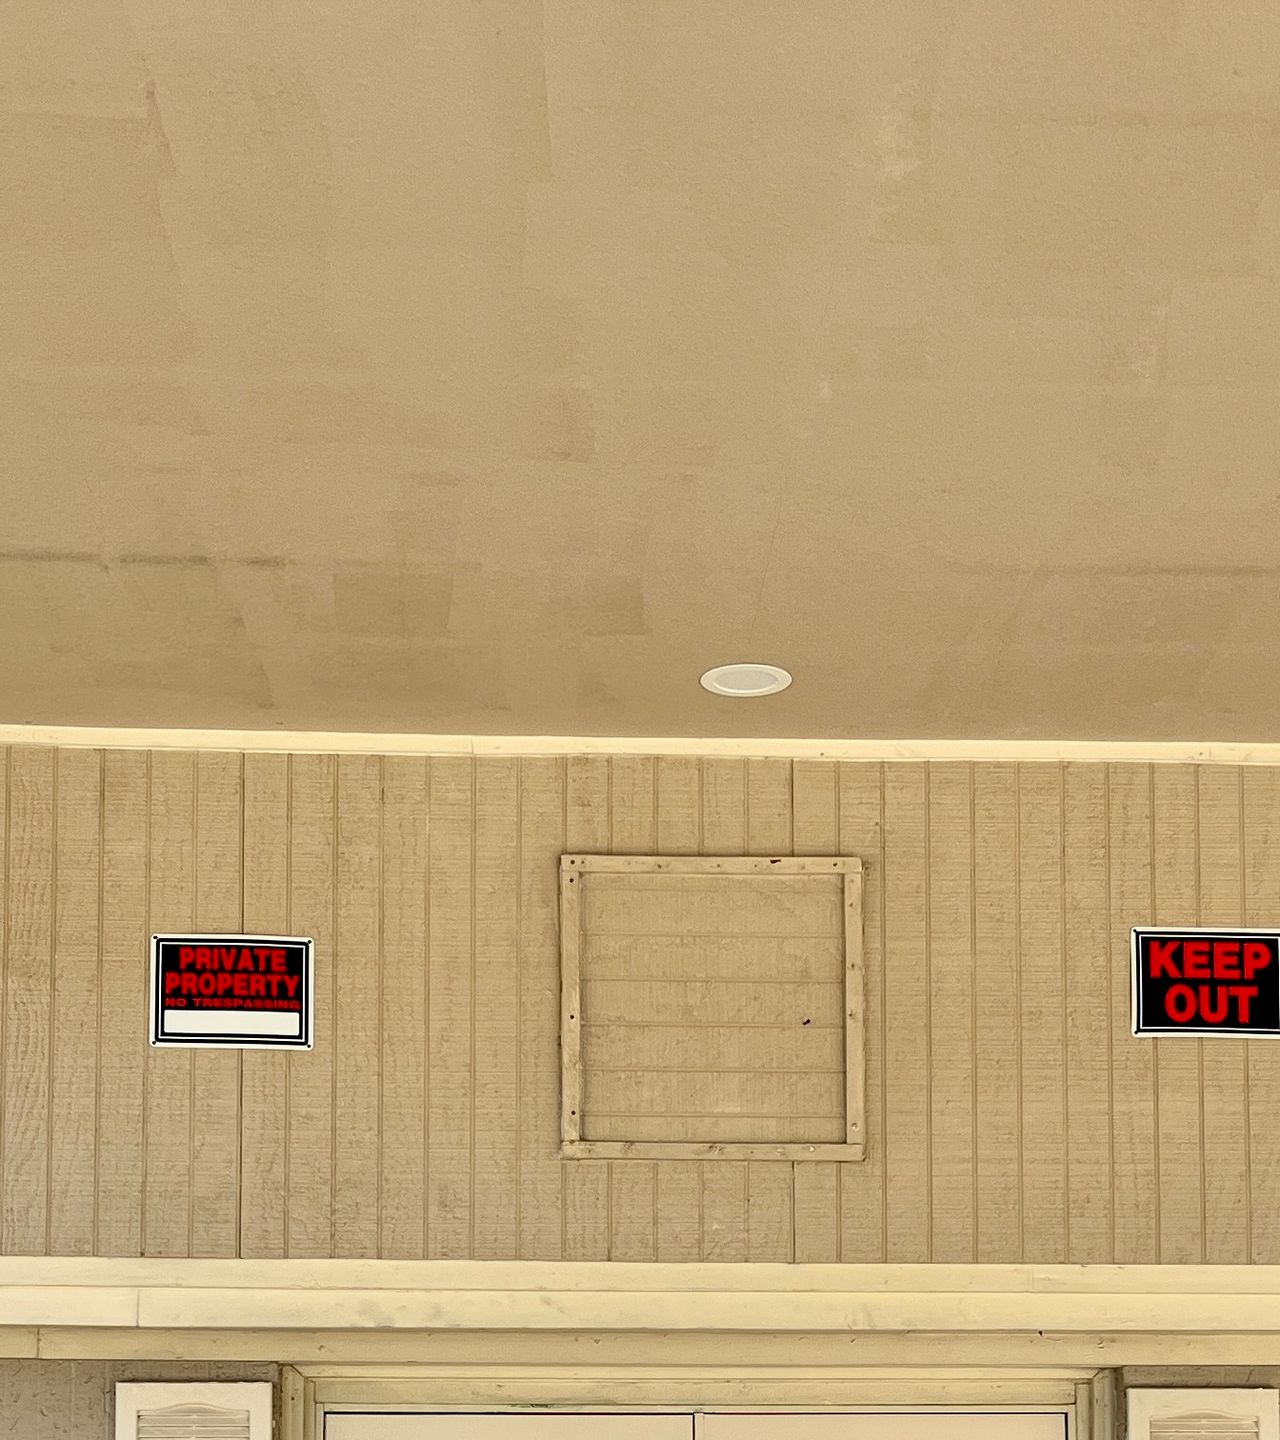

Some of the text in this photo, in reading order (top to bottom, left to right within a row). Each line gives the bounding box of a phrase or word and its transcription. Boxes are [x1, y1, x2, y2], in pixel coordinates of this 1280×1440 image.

[179, 946, 288, 972] PRIVATE
[1149, 940, 1271, 980] KEEP
[164, 972, 300, 997] PROPERTY
[165, 998, 301, 1010] NO TRESPASSING
[1164, 984, 1259, 1024] OUT
